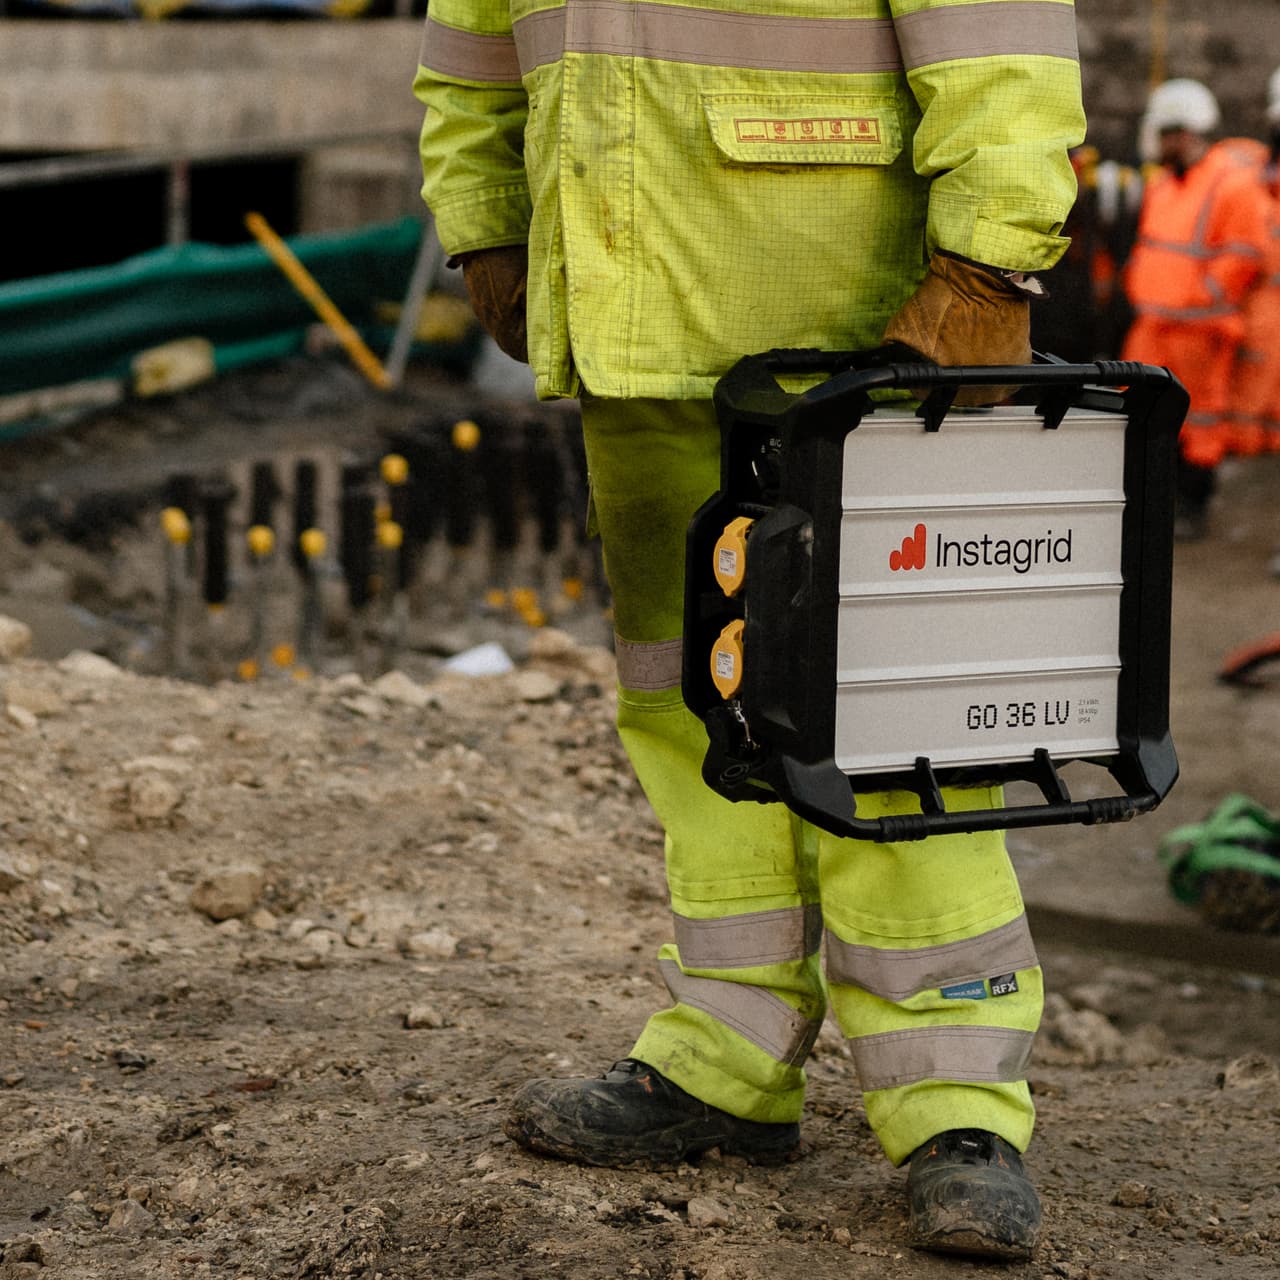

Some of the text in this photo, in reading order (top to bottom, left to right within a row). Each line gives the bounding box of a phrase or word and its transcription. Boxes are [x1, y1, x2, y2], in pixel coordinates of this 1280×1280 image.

[936, 529, 1072, 574] Instagrid
[967, 700, 1069, 729] GO 36 LV
[992, 981, 1017, 996] RFX
